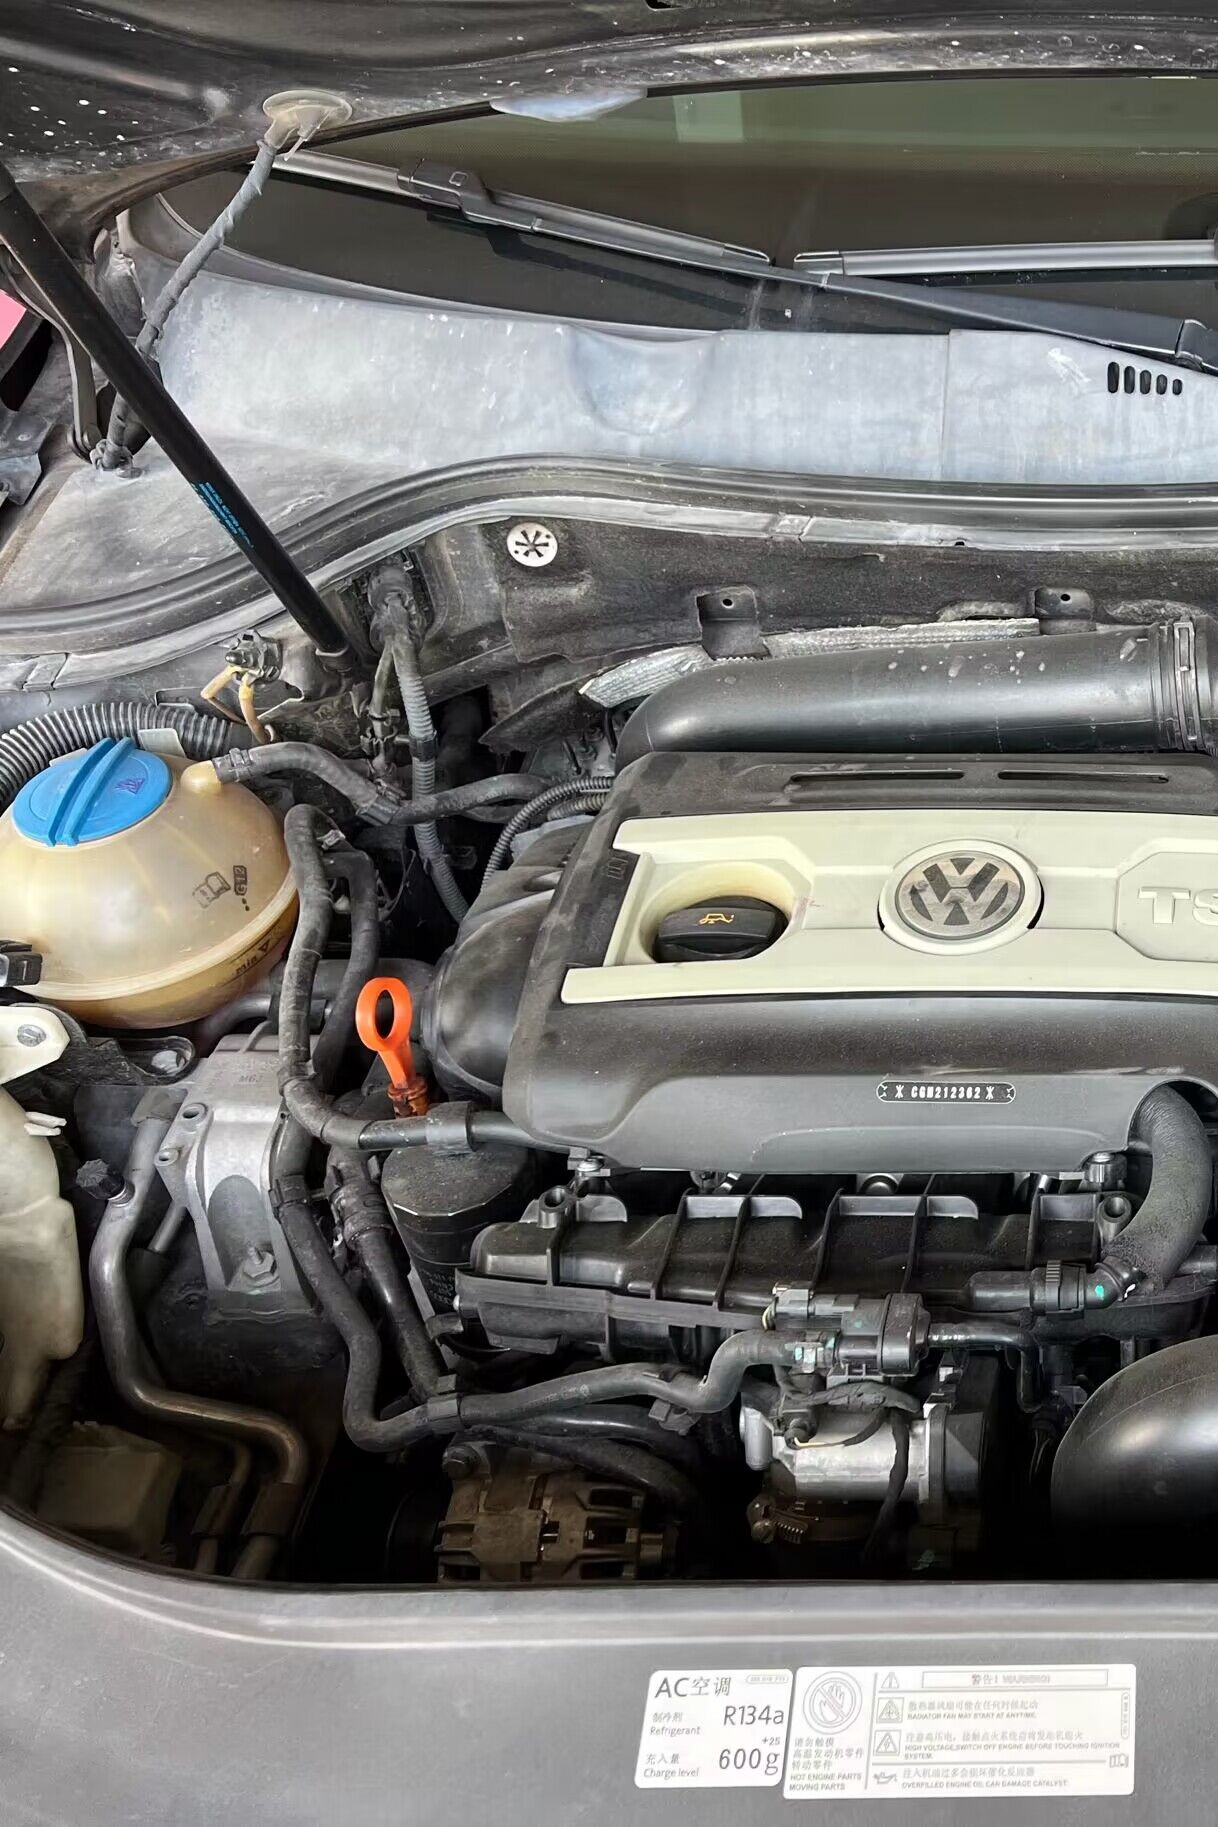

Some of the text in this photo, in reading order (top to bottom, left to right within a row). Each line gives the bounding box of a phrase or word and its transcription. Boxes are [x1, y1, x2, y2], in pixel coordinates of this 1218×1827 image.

[723, 1704, 785, 1726] R134a
[943, 1712, 957, 1720] FAN
[958, 1712, 972, 1720] MAY
[650, 1726, 701, 1737] Refrigerant
[983, 1743, 996, 1751] OFF
[1054, 1742, 1089, 1750] TOUCHING
[643, 1767, 700, 1780] Charge level
[807, 1773, 836, 1781] ENGINE
[837, 1772, 862, 1780] PARTS
[788, 1783, 846, 1792] MOVING PARTS
[901, 1781, 944, 1789] OVERFILLED
[985, 1780, 1001, 1788] CAN
